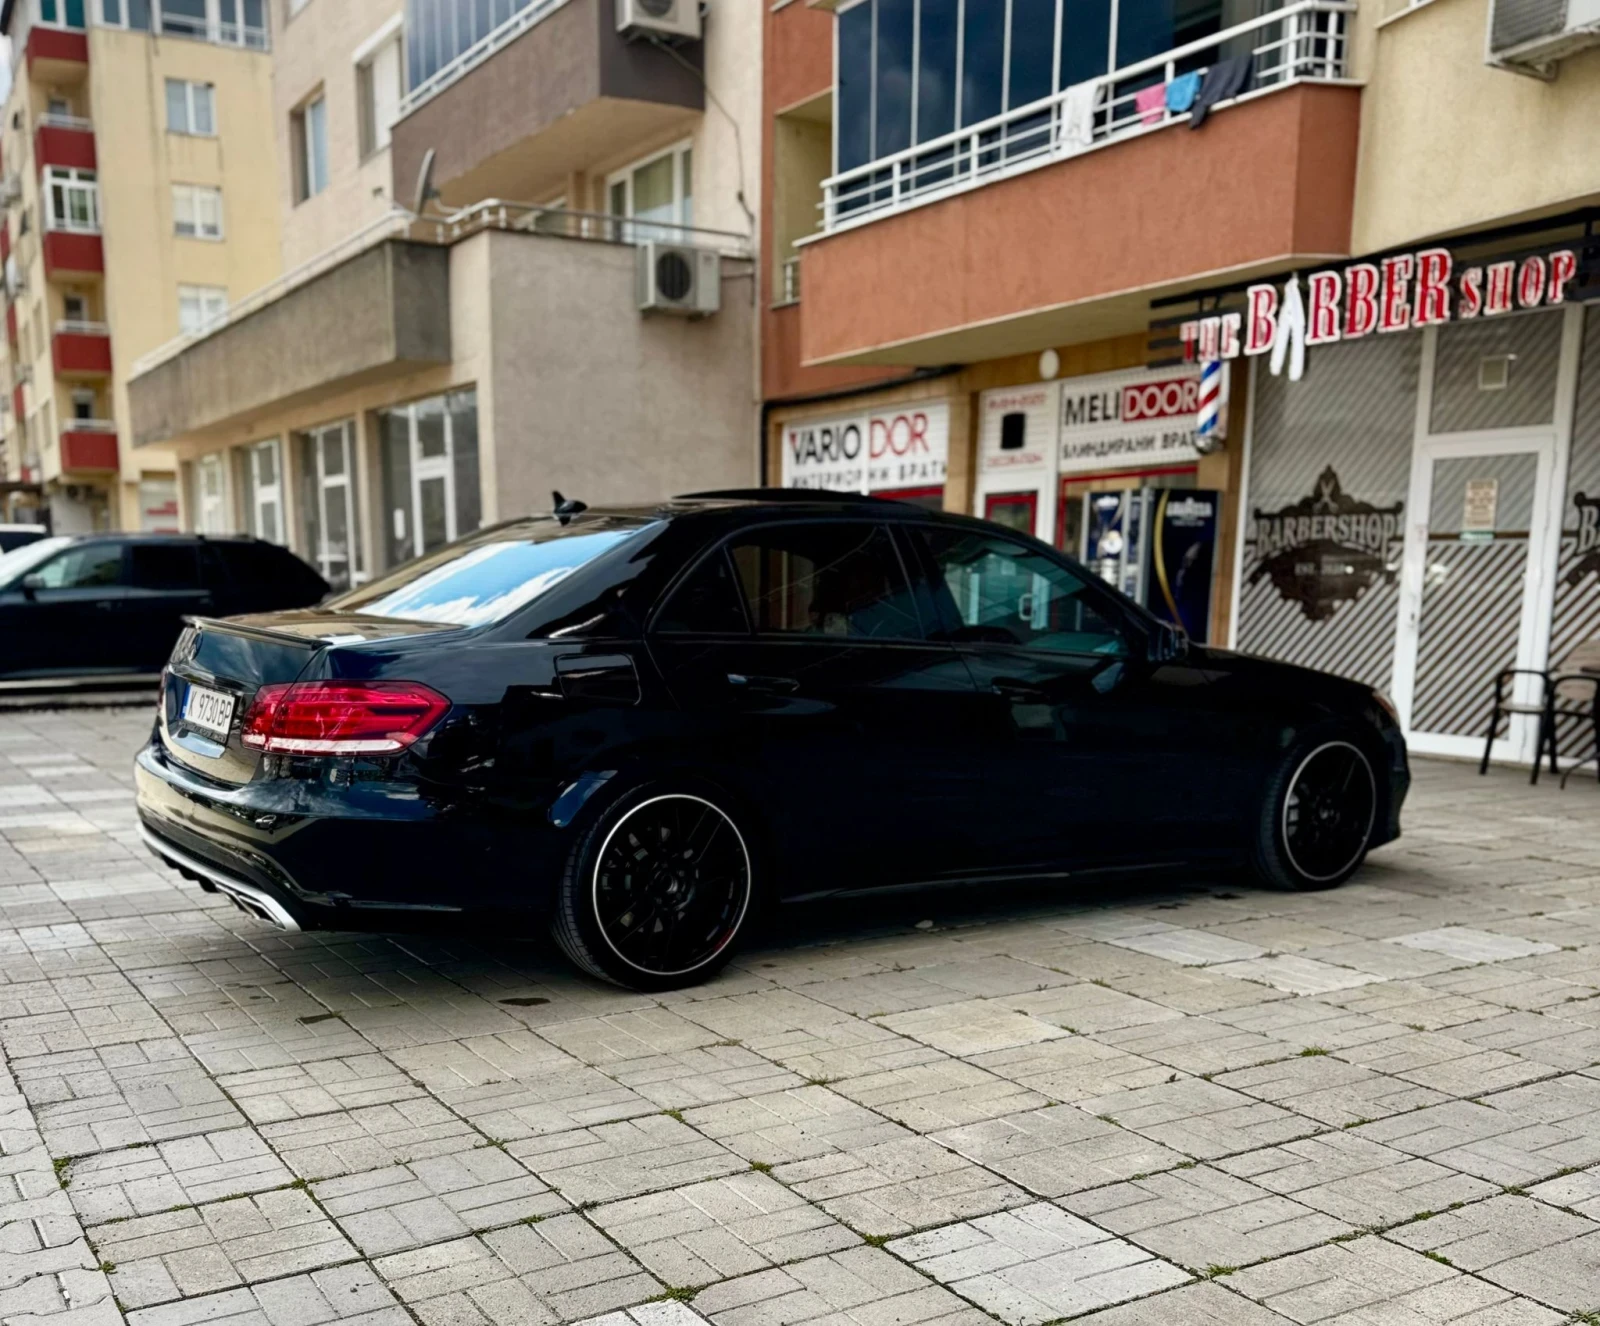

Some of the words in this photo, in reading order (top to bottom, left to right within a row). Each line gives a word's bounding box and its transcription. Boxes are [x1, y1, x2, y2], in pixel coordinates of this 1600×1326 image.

[1179, 313, 1241, 363] THE
[1244, 248, 1453, 381] BARBER
[1458, 250, 1577, 319] SHOP
[789, 424, 862, 465] VARIO
[869, 411, 930, 459] DOR
[1256, 512, 1396, 560] BARBERSHOP
